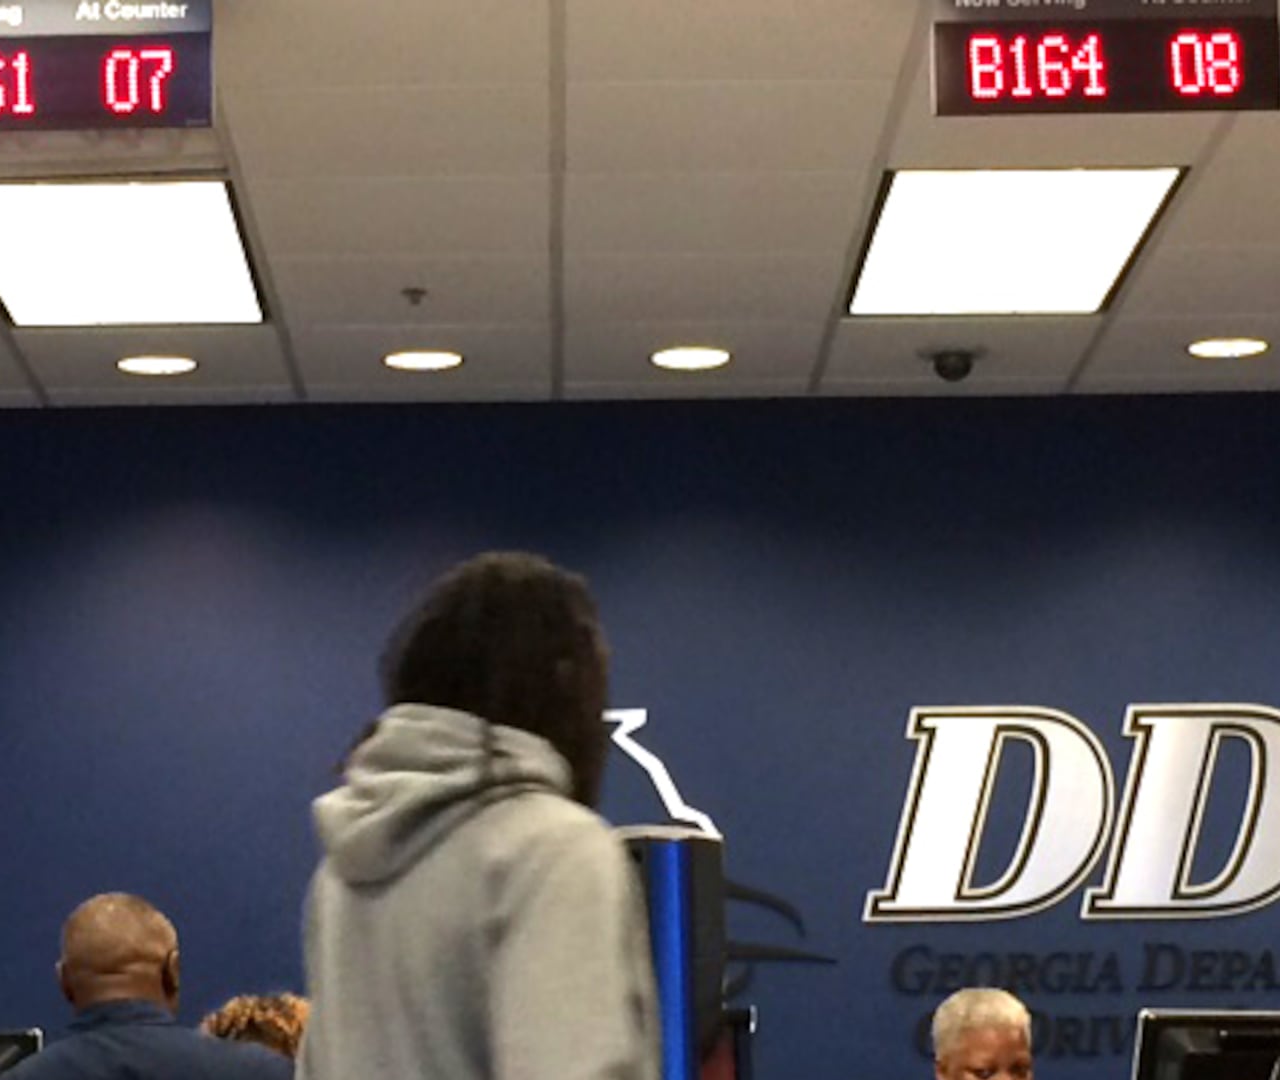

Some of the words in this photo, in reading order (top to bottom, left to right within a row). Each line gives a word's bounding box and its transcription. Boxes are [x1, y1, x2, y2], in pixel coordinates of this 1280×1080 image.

[75, 2, 100, 21] At
[104, 1, 188, 20] Counter
[104, 49, 174, 113] 07
[969, 35, 1107, 98] B164
[1170, 32, 1240, 95] 08
[890, 943, 1124, 996] GEORGIA
